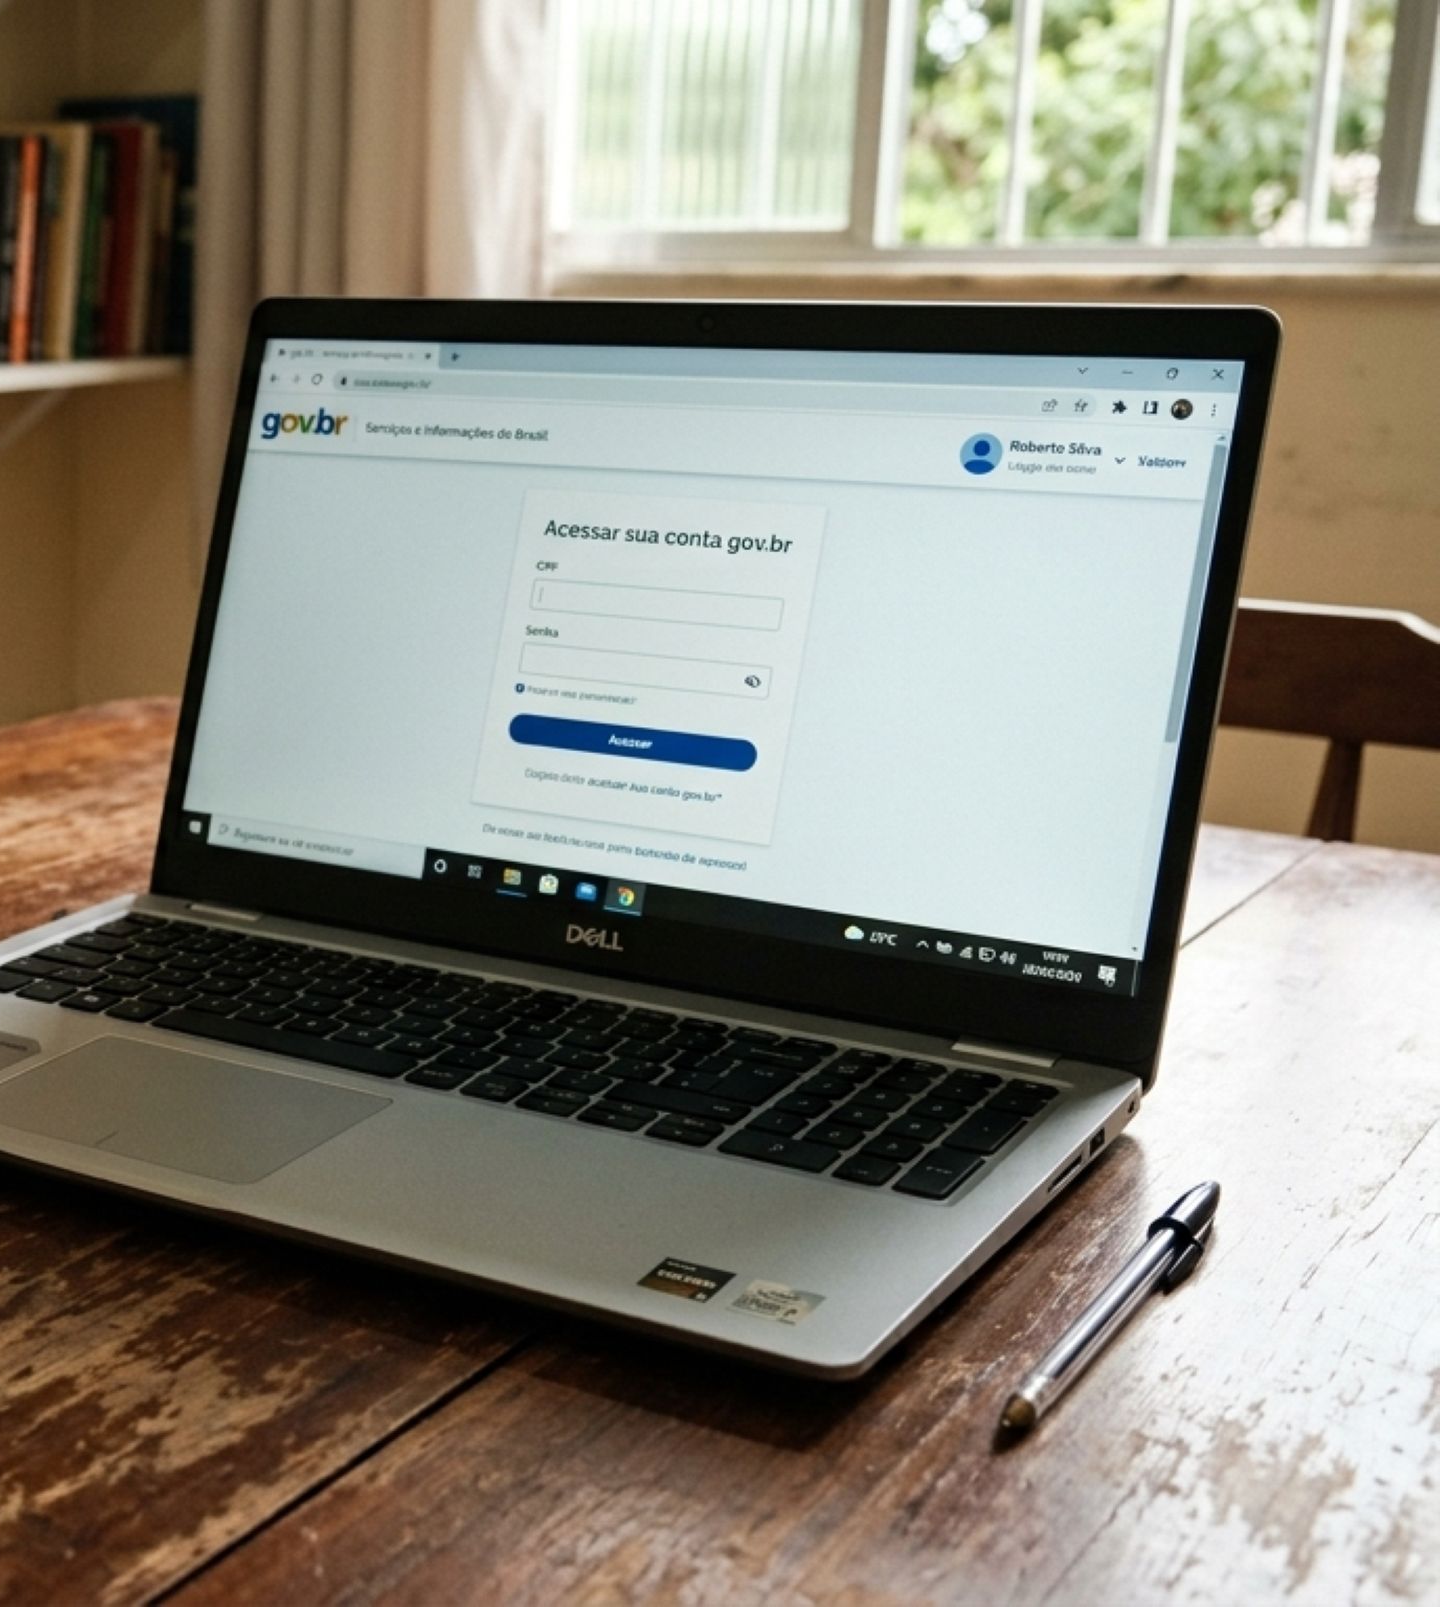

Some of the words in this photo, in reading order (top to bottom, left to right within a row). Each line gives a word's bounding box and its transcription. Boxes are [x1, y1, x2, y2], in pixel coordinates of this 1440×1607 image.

[261, 407, 349, 440] gov.br
[544, 519, 621, 541] Acessar
[624, 526, 660, 544] sua
[664, 529, 723, 548] conta
[727, 534, 793, 555] gov.br
